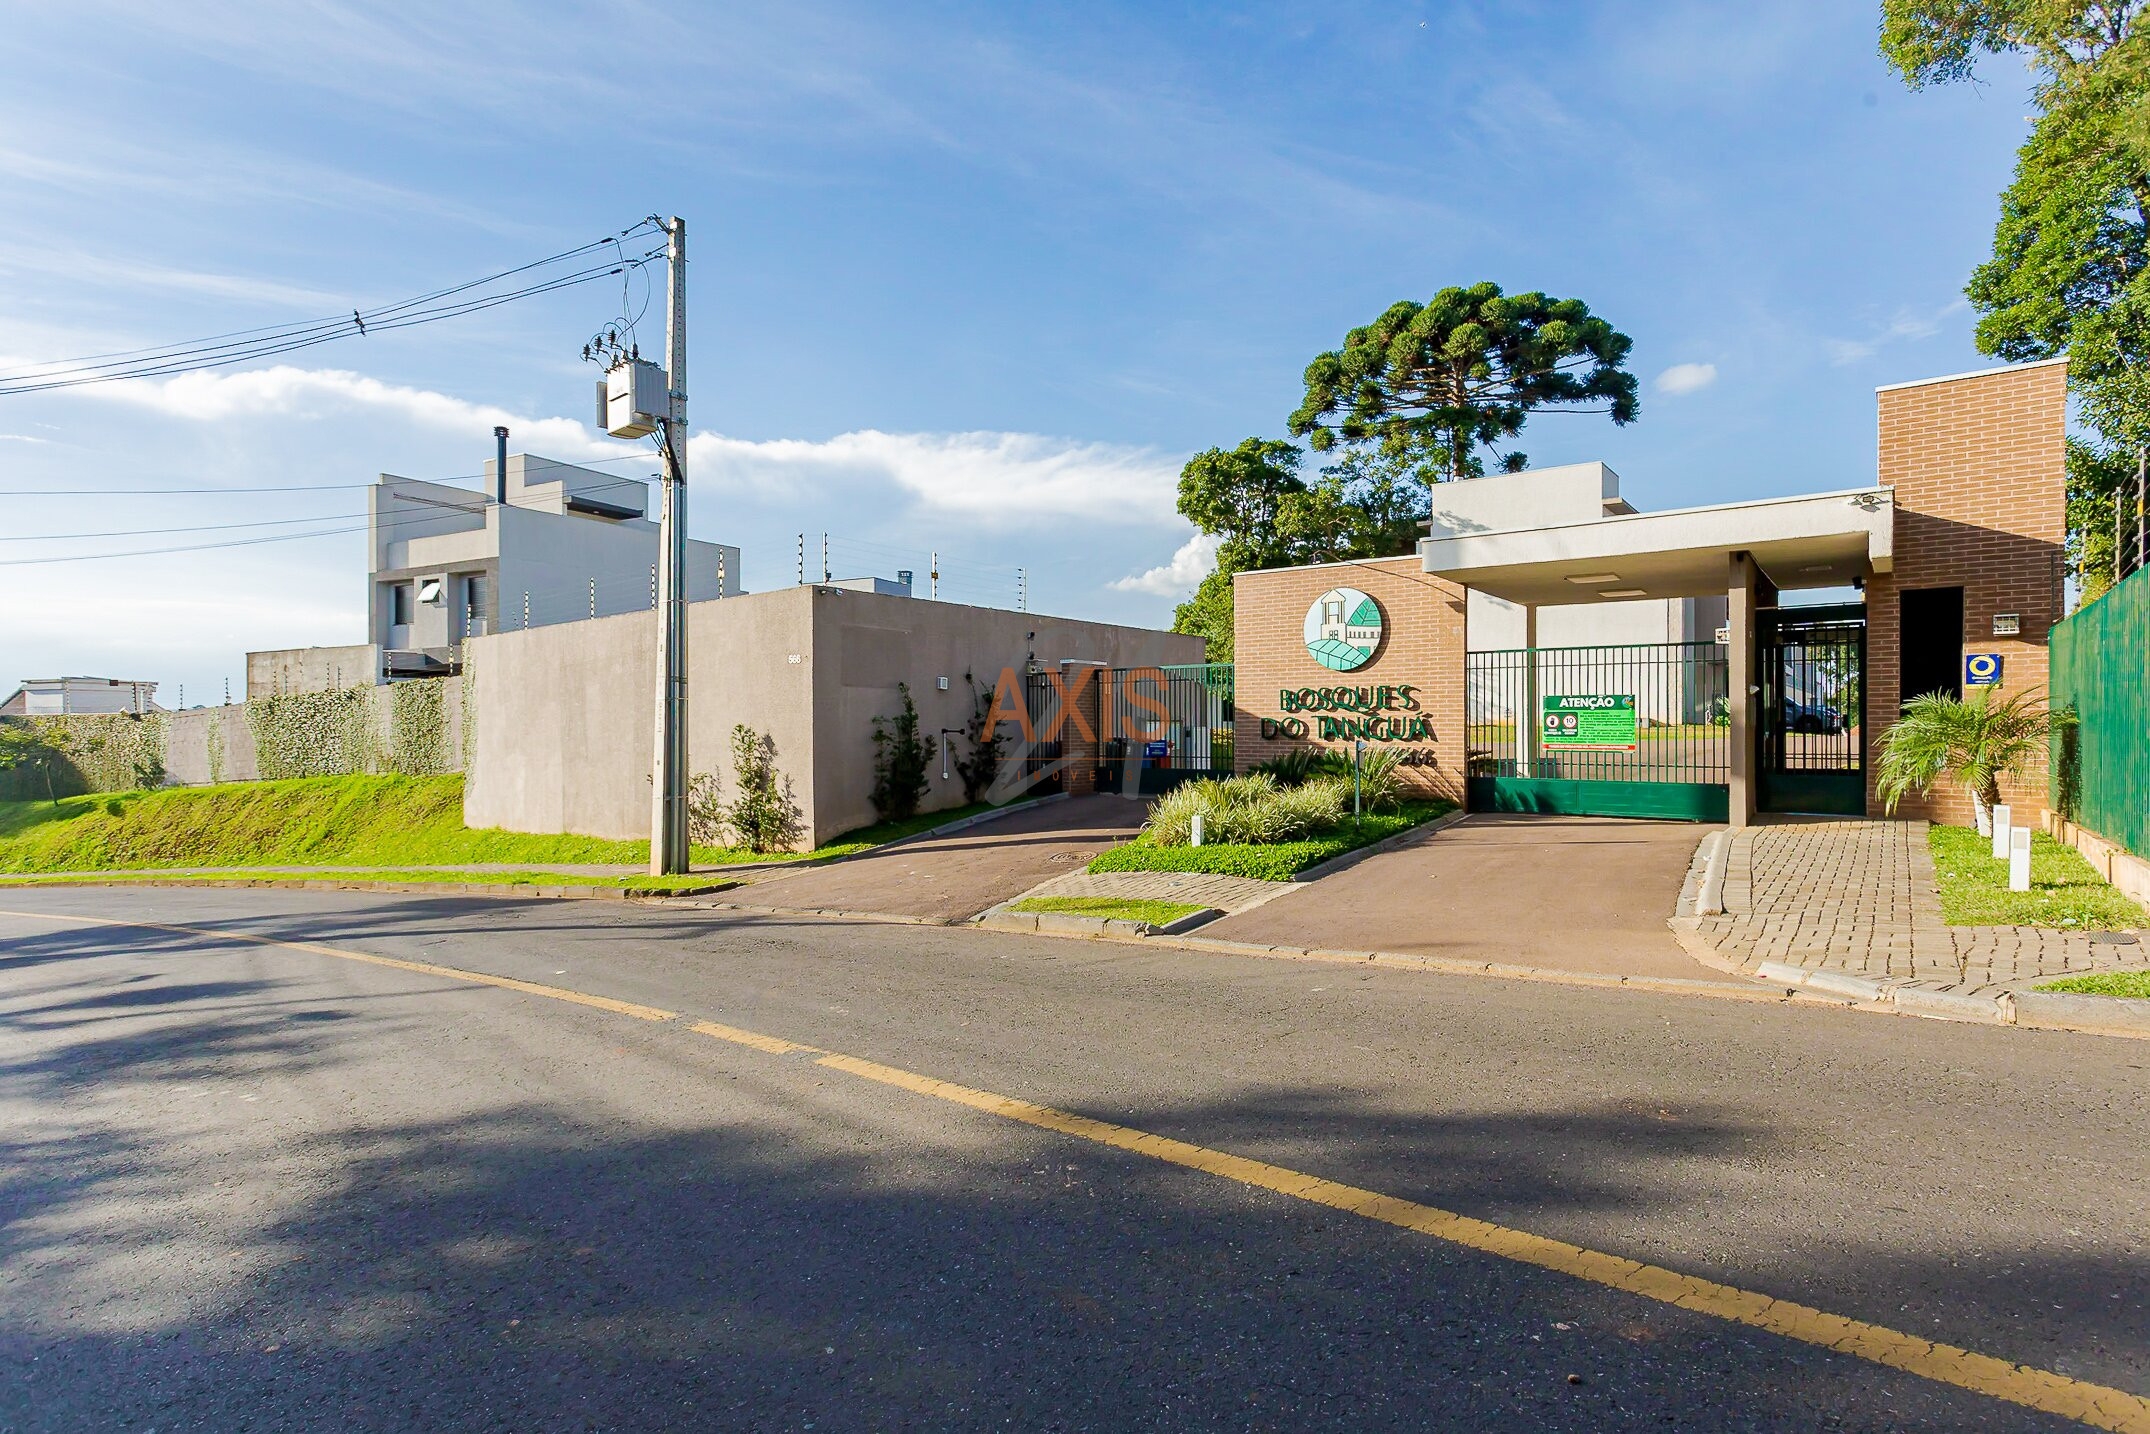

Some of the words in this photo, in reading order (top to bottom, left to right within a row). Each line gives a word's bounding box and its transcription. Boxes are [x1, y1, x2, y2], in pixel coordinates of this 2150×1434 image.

[1280, 685, 1412, 714] BOSQUES
[1559, 695, 1615, 710] ATENÇÃO
[1260, 716, 1301, 740] DO
[1311, 711, 1428, 738] TANGUÁ
